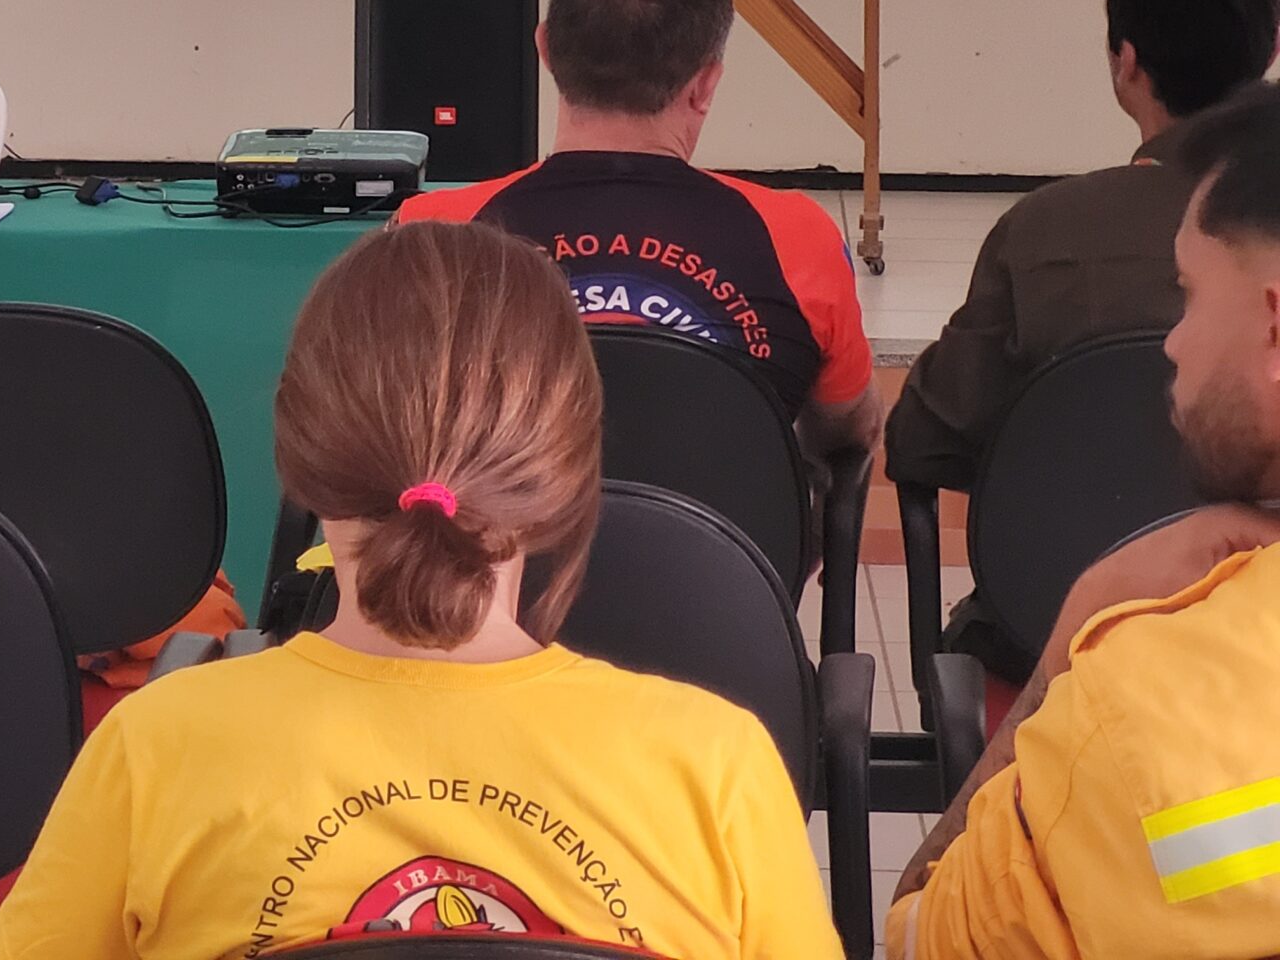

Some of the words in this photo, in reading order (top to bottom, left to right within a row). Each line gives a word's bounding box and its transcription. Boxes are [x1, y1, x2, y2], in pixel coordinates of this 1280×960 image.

[552, 233, 599, 261] ÃO
[608, 233, 631, 256] A
[639, 237, 771, 359] DESASTRES
[286, 779, 422, 873] NACIONAL
[429, 778, 470, 803] DE
[479, 783, 627, 920] PREVENÇÃO
[393, 865, 500, 897] IBAMA
